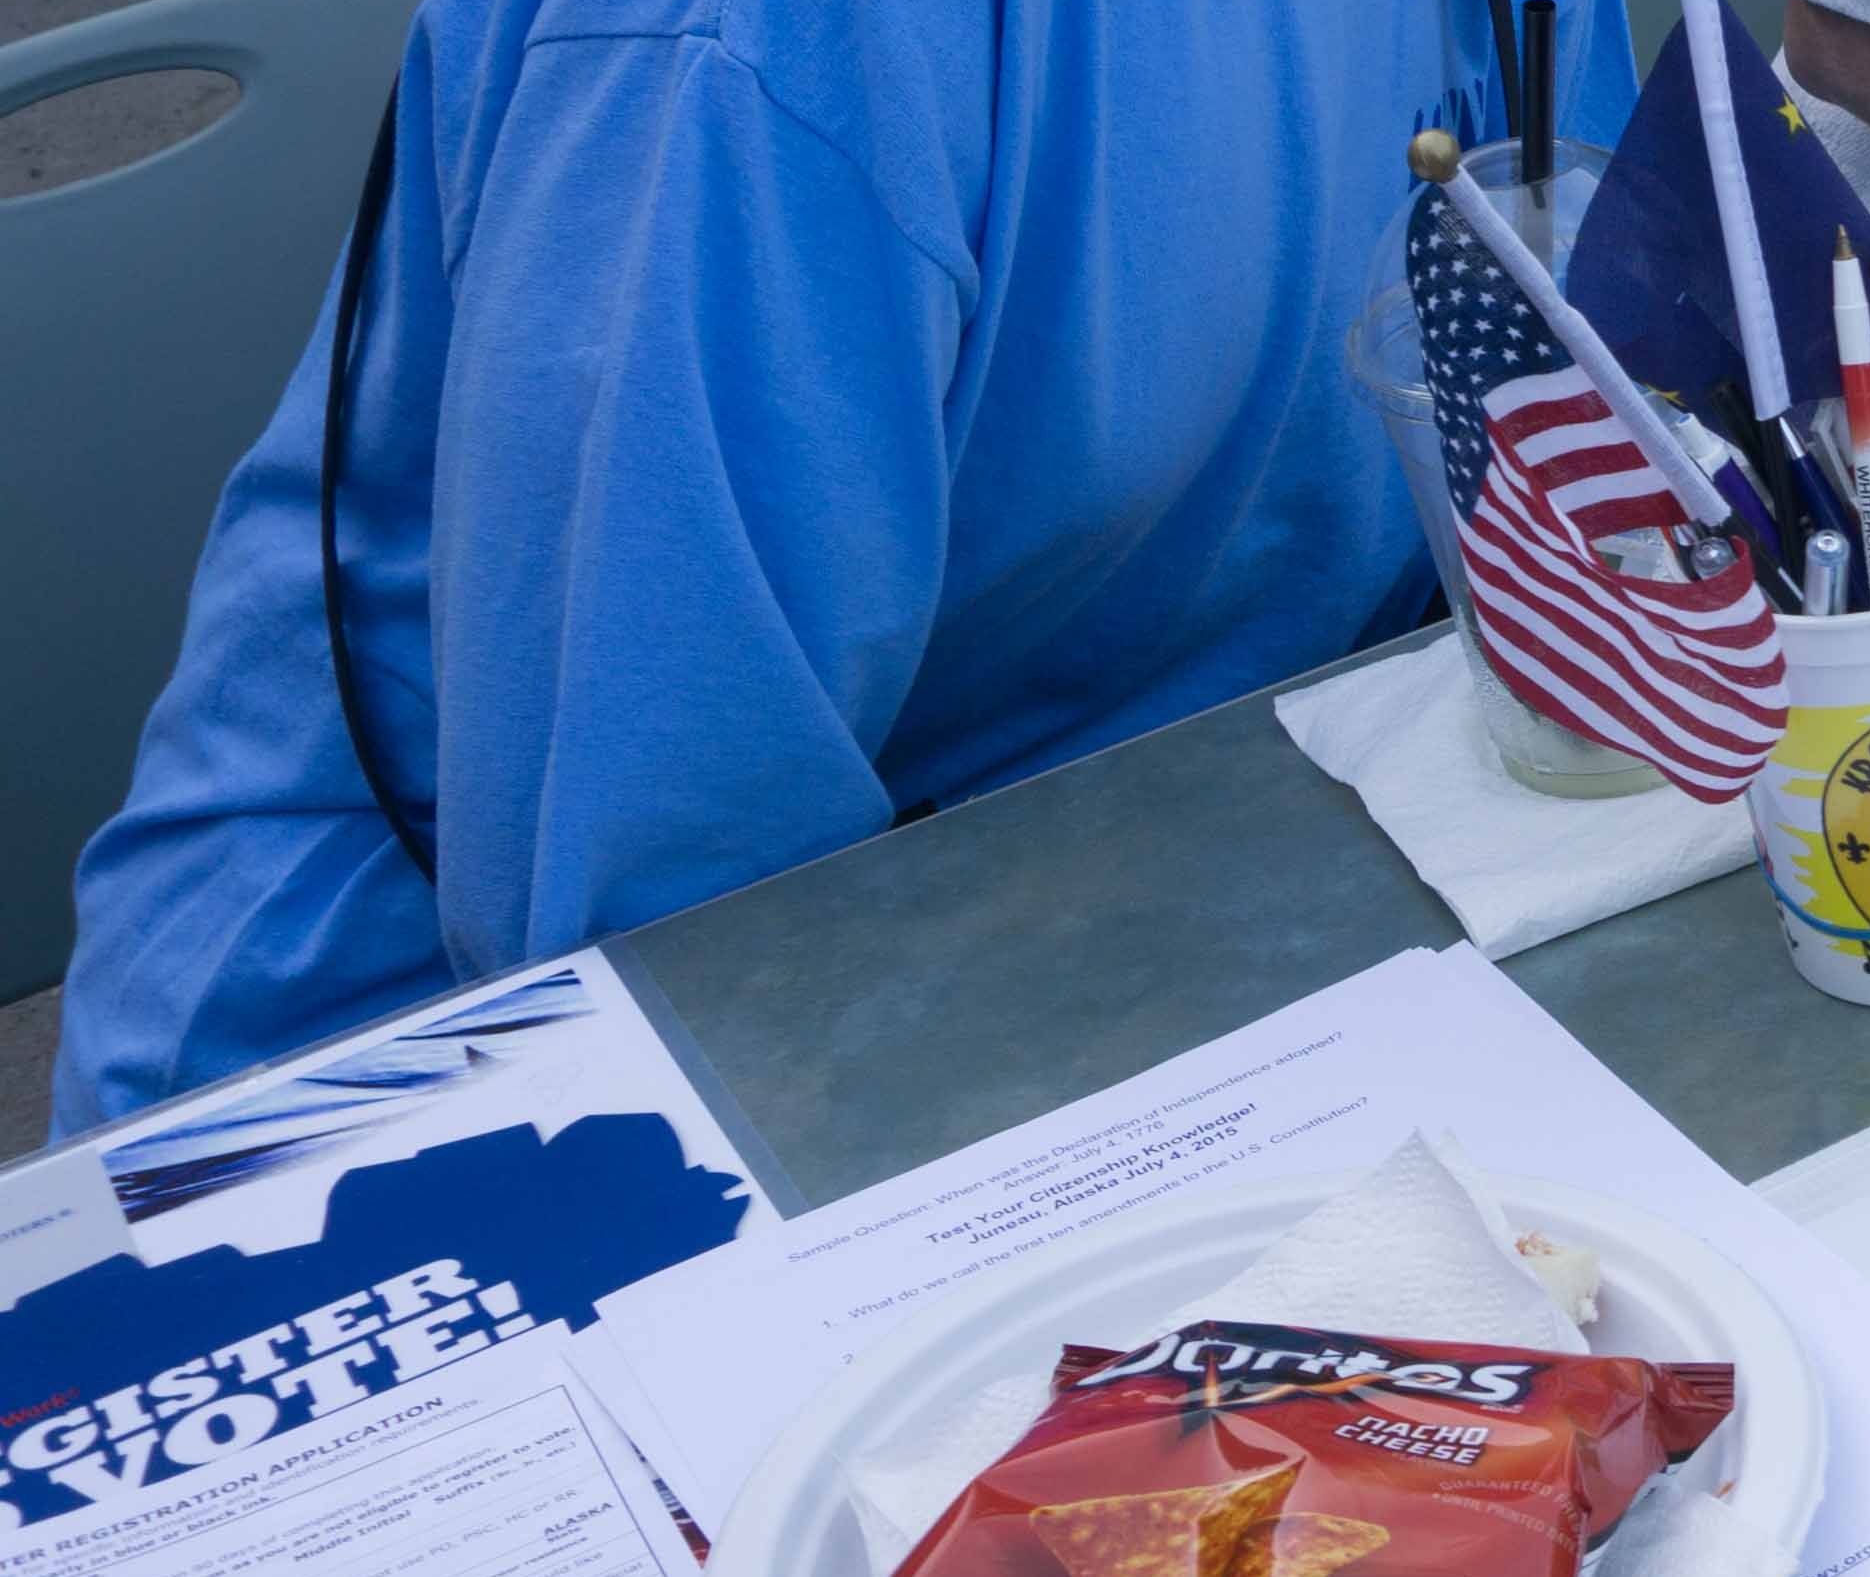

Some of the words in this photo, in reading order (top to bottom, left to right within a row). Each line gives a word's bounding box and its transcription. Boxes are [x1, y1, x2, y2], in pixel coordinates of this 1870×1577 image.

[924, 1219, 973, 1246] Test
[975, 1197, 1026, 1226] Your
[1027, 1151, 1140, 1205] Citizenship
[1141, 1101, 1258, 1158] Knowledge!
[932, 1177, 985, 1206] When
[984, 1163, 1020, 1185] was
[1021, 1151, 1049, 1170] the
[1050, 1114, 1141, 1158] Declaration
[1142, 1107, 1159, 1120] of
[1161, 1060, 1272, 1113] Independence
[1275, 1028, 1344, 1066] adopted?
[1070, 1144, 1102, 1163] July
[1125, 1118, 1166, 1141] 1776
[847, 1295, 895, 1321] What
[895, 1284, 920, 1302] do
[919, 1273, 949, 1292] we
[949, 1260, 980, 1280] call
[981, 1248, 1011, 1267] the
[1013, 1233, 1047, 1254] first
[1047, 1222, 1075, 1240] ten
[1076, 1179, 1182, 1229] amendments
[1183, 1170, 1201, 1185] to
[1202, 1158, 1227, 1176] the
[1267, 1093, 1369, 1146] Constitution?
[965, 1204, 1048, 1246] Juneau,
[1050, 1175, 1120, 1211] Alaska
[1122, 1155, 1166, 1182] July
[1167, 1145, 1189, 1163] 4,
[1191, 1124, 1239, 1153] 2015
[0, 1258, 480, 1470] GISTER
[49, 1281, 535, 1488] VOTE!
[1073, 1333, 1534, 1403] Doritos
[53, 1471, 259, 1553] REGISTRATION
[263, 1396, 444, 1477] APPLICATION
[254, 1543, 288, 1561] you
[291, 1530, 321, 1547] are
[323, 1516, 353, 1535] not
[354, 1489, 419, 1521] eligible
[420, 1479, 442, 1494] to
[442, 1452, 509, 1485] register
[512, 1442, 531, 1456] to
[533, 1423, 576, 1446] vote.
[1334, 1424, 1481, 1465] CHEESE
[1357, 1416, 1490, 1446] NACHO
[185, 1507, 236, 1532] black
[292, 1532, 353, 1562] Middle
[357, 1507, 412, 1536] Initial
[432, 1477, 484, 1504] Suffix
[541, 1499, 613, 1536] ALASKA
